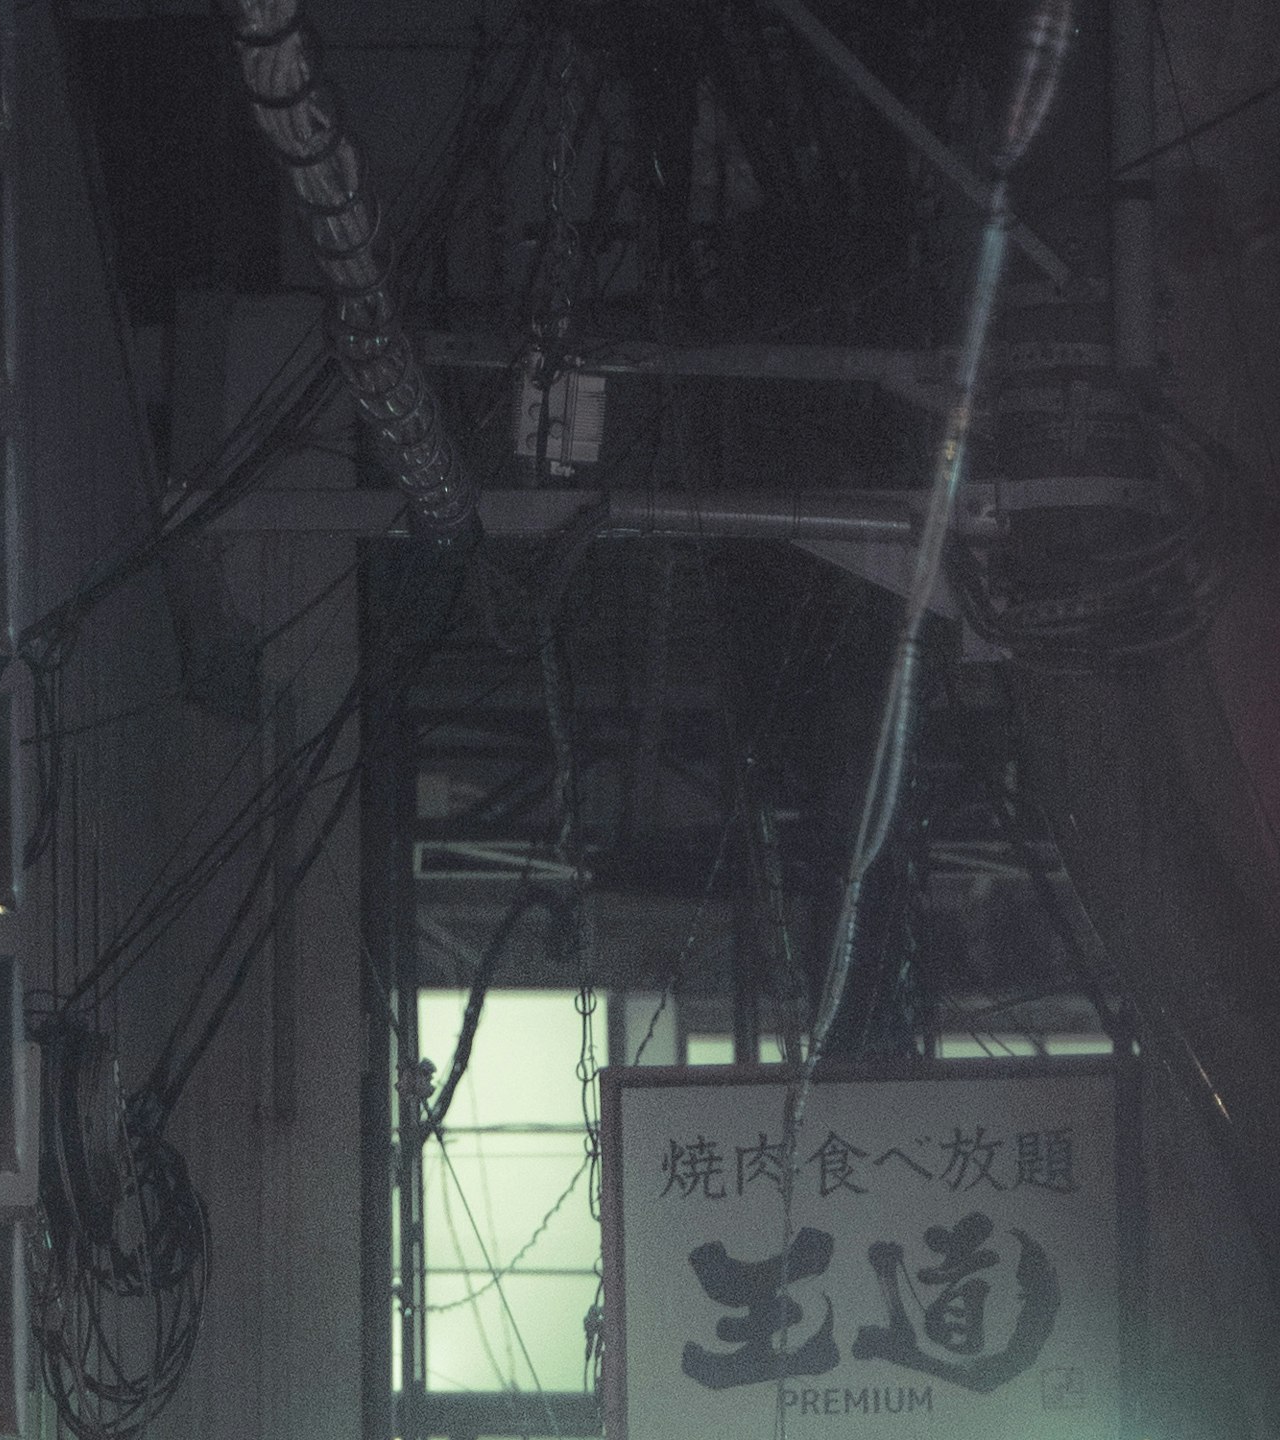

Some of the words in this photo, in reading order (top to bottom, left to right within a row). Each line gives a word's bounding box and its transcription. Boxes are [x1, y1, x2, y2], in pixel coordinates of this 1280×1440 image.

[658, 1122, 1080, 1203] 焼肉食べ放題
[681, 1211, 1061, 1393] 王道
[775, 1386, 936, 1418] PREMIUM
